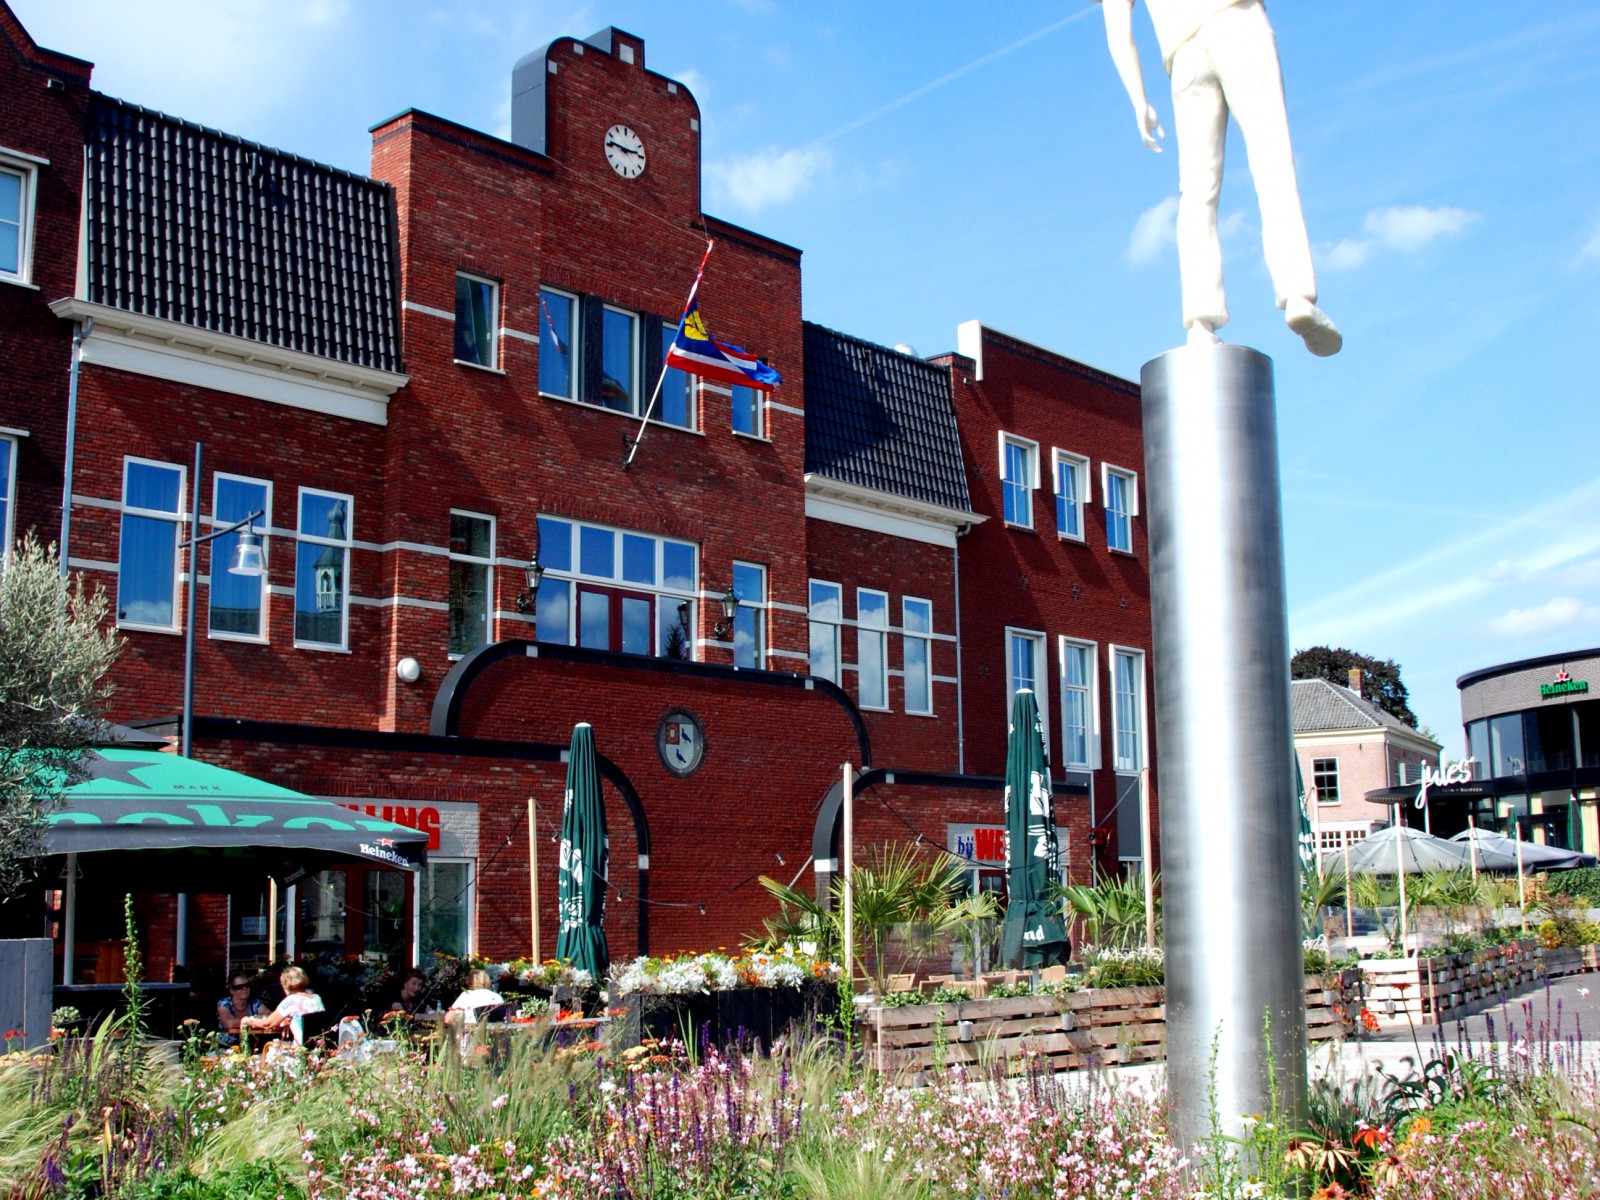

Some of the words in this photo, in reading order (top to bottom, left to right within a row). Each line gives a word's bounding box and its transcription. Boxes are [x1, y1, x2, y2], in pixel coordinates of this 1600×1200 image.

[1539, 681, 1587, 695] Heineken
[1414, 751, 1475, 809] jules
[360, 843, 410, 867] Heineken
[957, 836, 974, 859] bij
